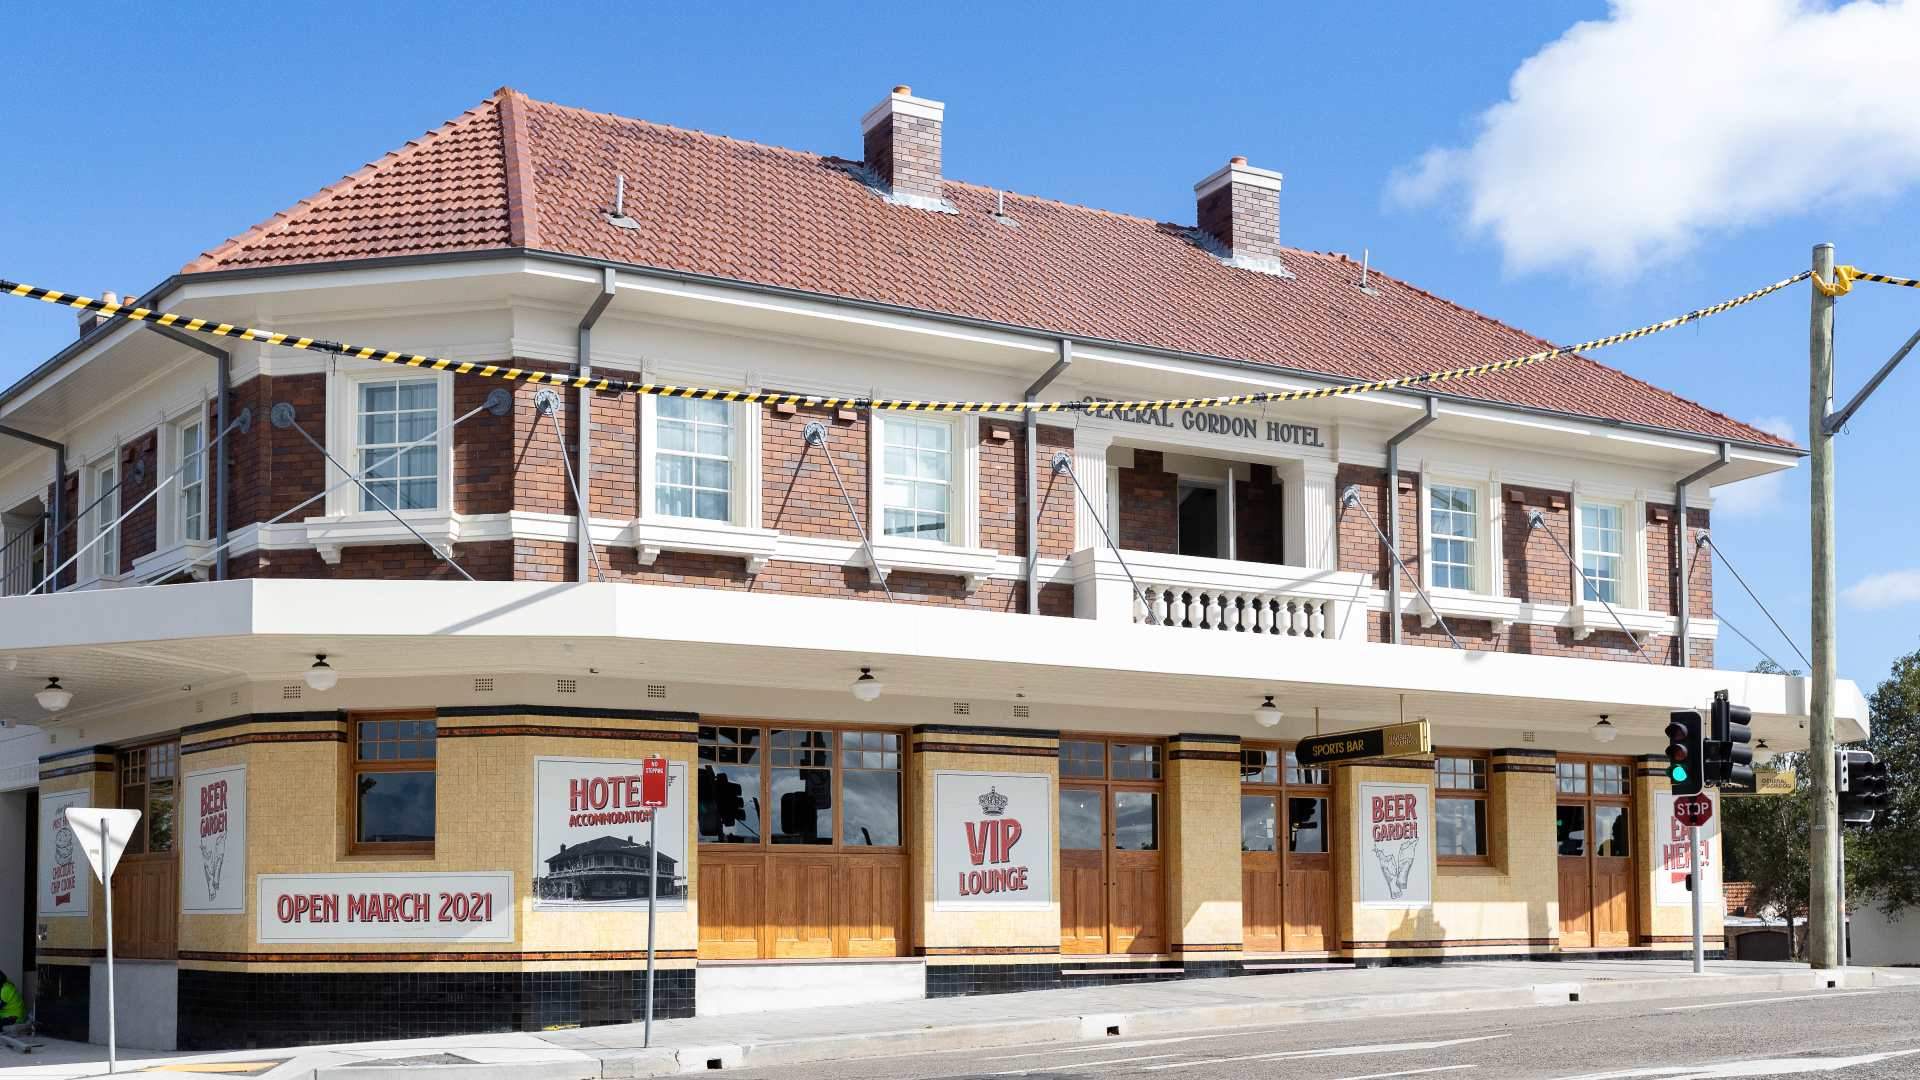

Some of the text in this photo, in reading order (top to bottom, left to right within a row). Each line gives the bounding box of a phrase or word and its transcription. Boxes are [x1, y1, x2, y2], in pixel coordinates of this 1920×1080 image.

[1181, 410, 1257, 439] GORDON
[1266, 421, 1325, 448] HOTEL
[1312, 739, 1364, 757] SPORTS BAR
[200, 780, 227, 817] BEER
[569, 775, 643, 811] HOTE
[569, 809, 653, 828] ACCOMMODATION
[1371, 794, 1418, 823] BEER
[1677, 802, 1709, 816] STOP
[200, 811, 227, 838] GARDEN
[1372, 821, 1418, 842] GARDEN
[964, 818, 1022, 865] VIP
[959, 866, 1028, 896] LOUNGE
[277, 892, 493, 923] OPEN MARCH 2021
